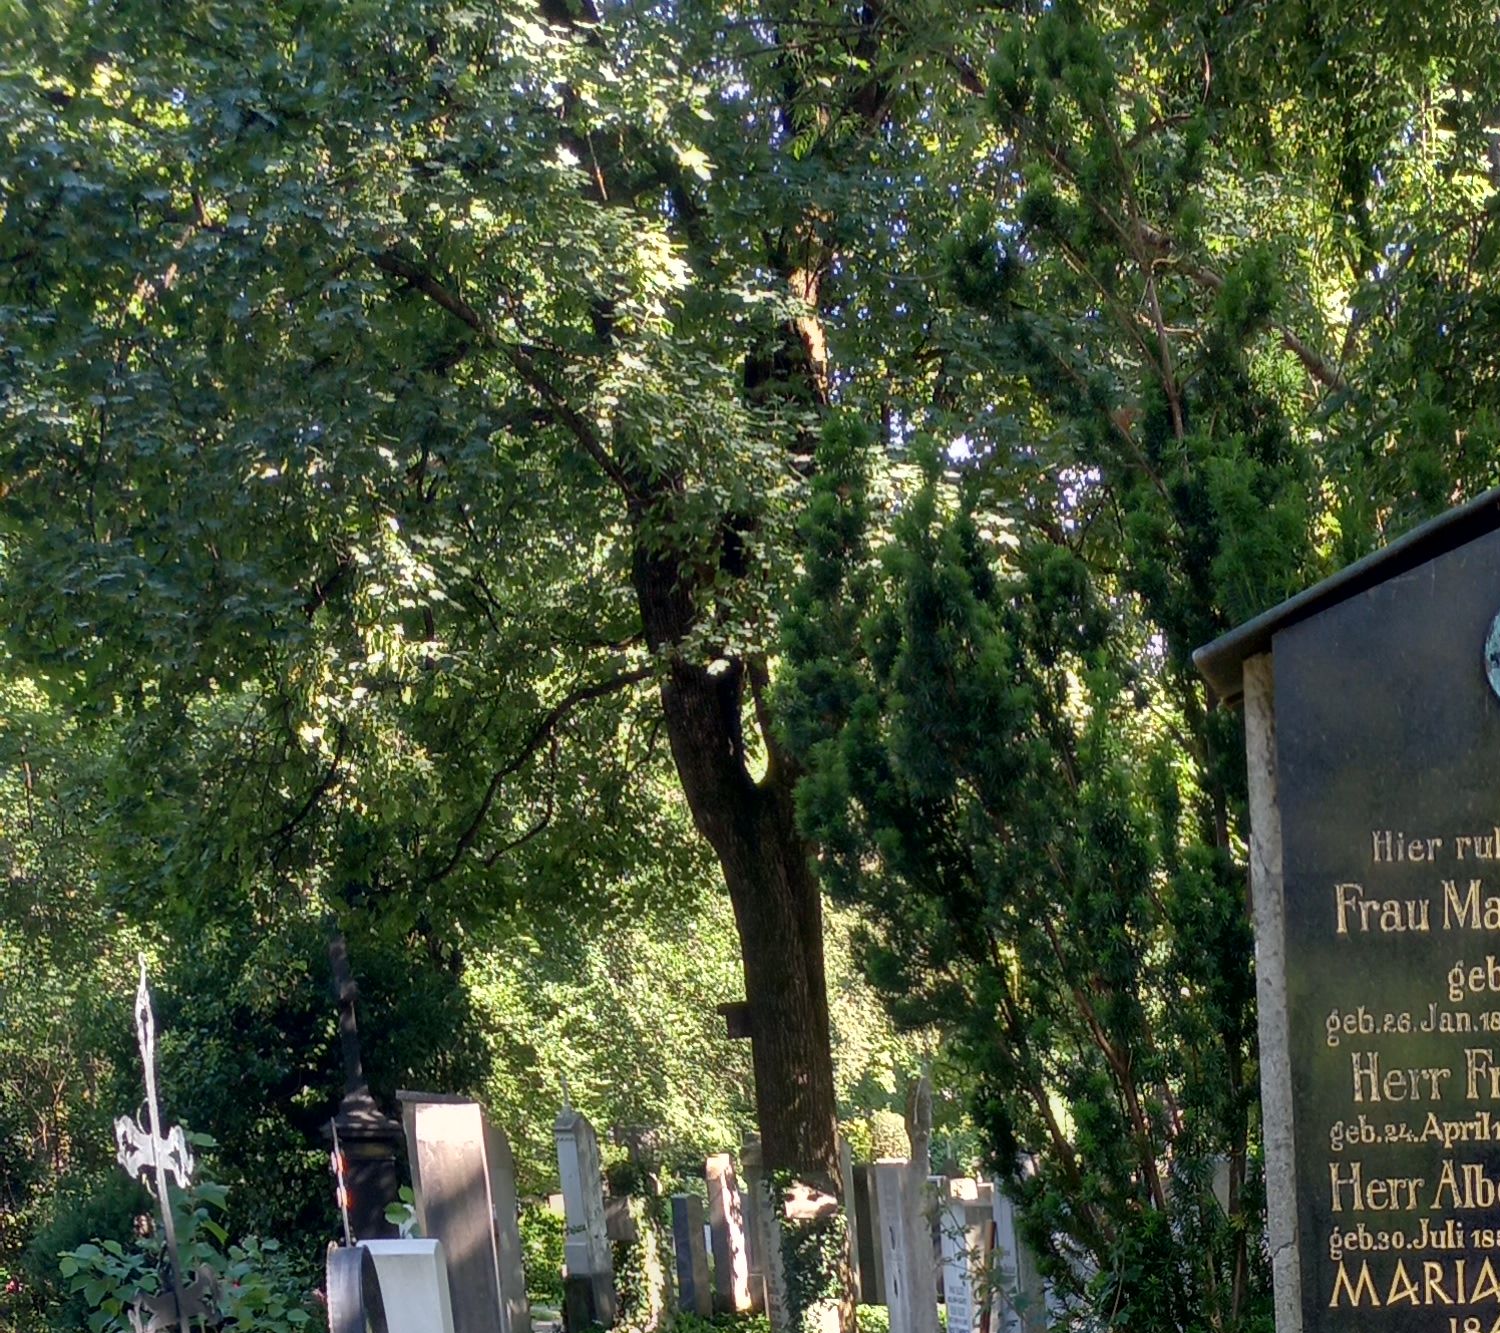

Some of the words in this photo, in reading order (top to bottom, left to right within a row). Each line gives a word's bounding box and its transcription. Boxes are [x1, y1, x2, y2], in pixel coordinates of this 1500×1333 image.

[1372, 830, 1442, 862] Hier
[1334, 882, 1430, 934] Frau
[1350, 1051, 1451, 1102] Herr
[1328, 1161, 1425, 1212] Herr
